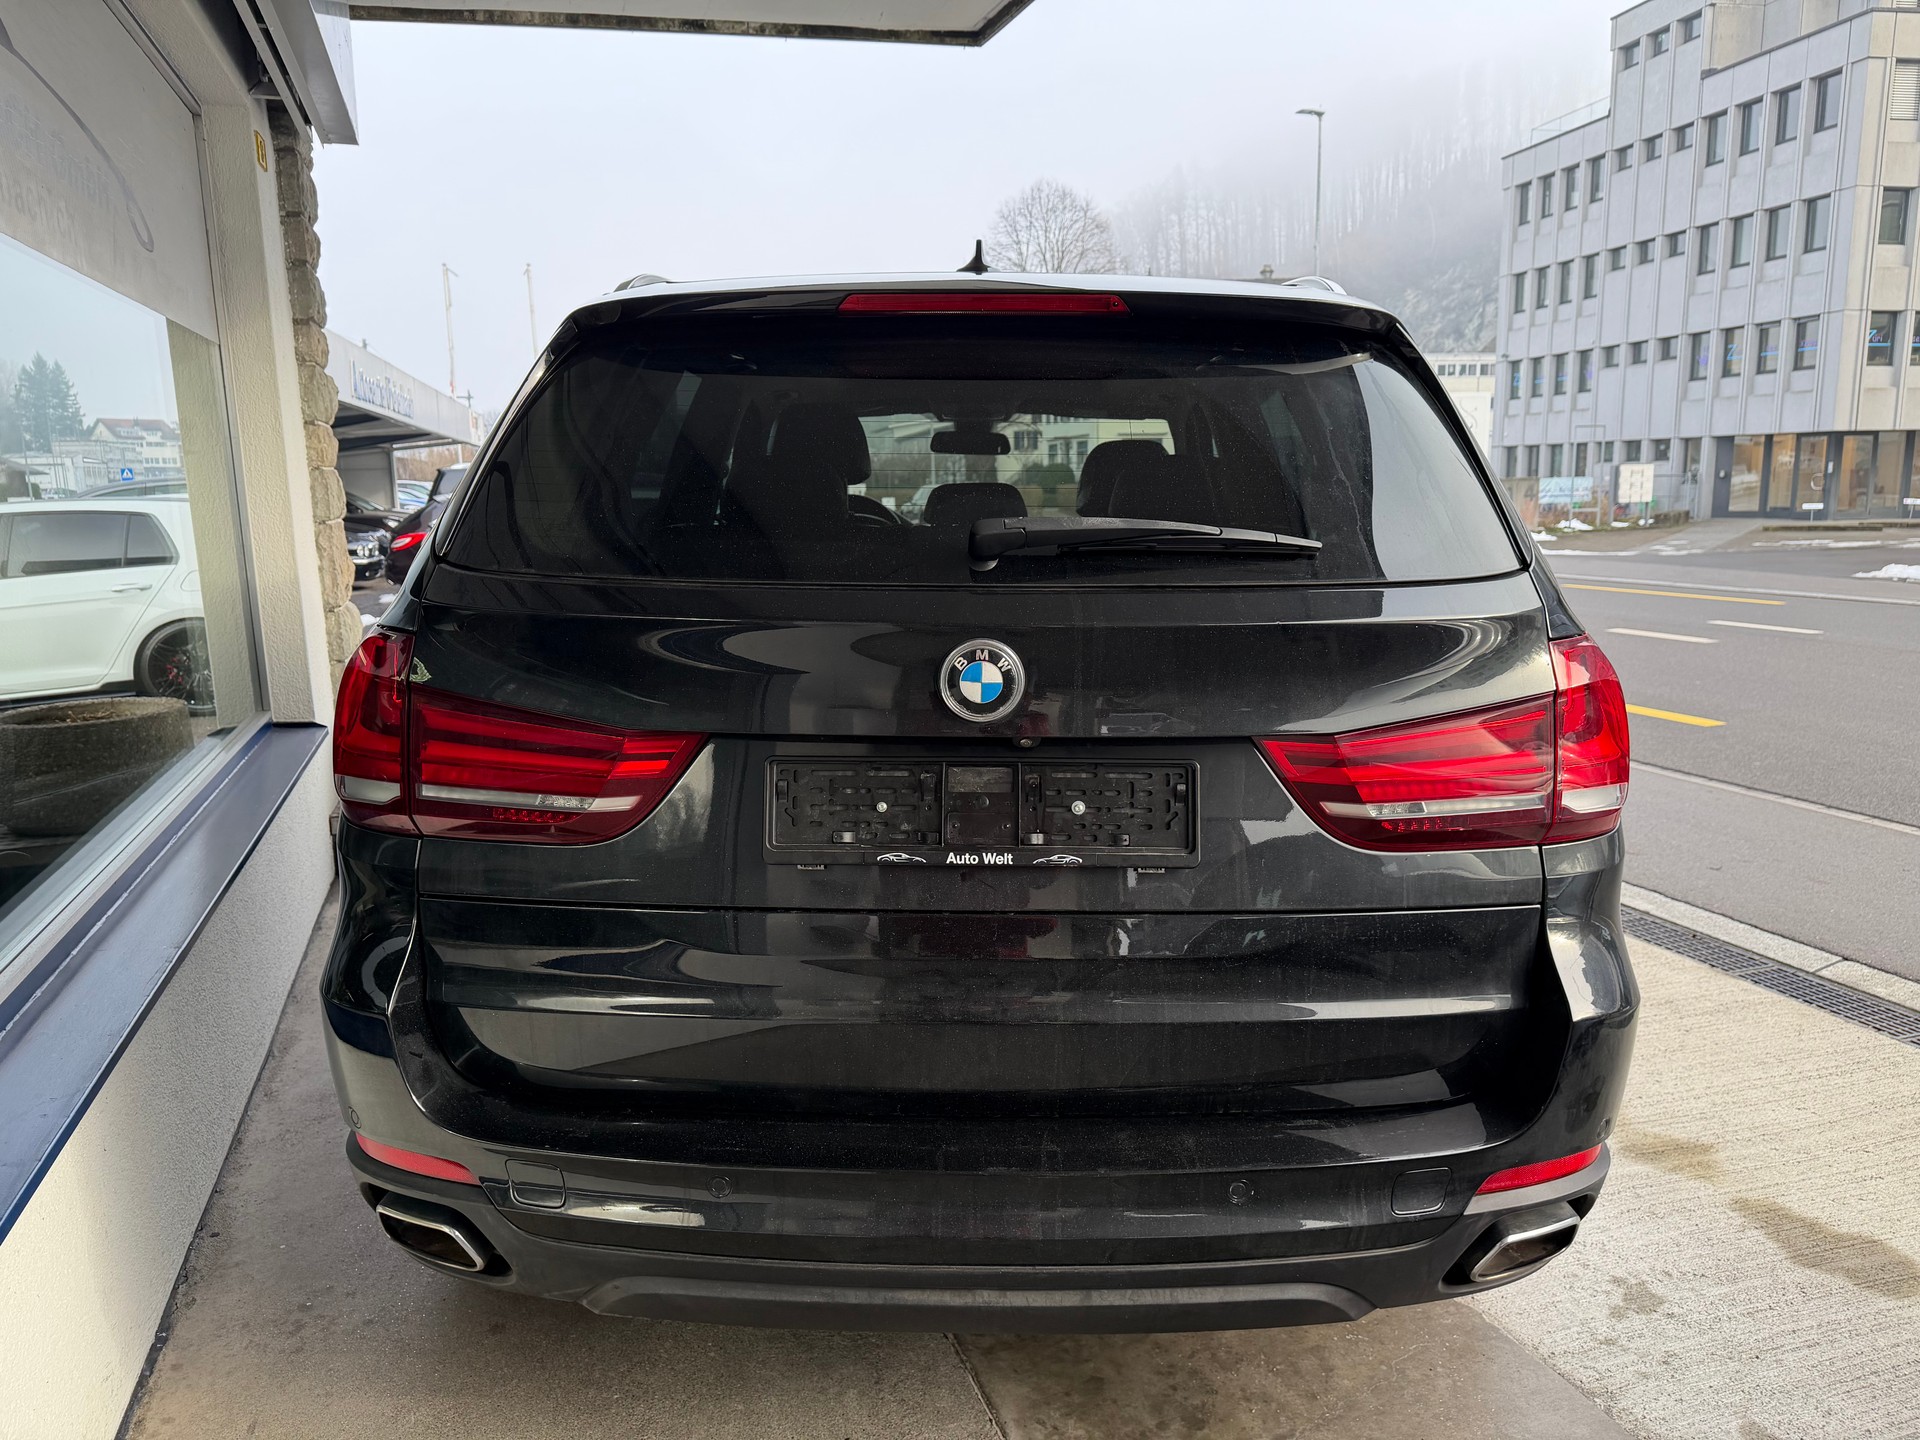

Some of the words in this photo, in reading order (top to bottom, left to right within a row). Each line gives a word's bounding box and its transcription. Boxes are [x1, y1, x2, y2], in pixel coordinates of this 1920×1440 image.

[953, 649, 1012, 673] BMW
[945, 852, 979, 865] Auto
[982, 852, 1014, 865] Welt
